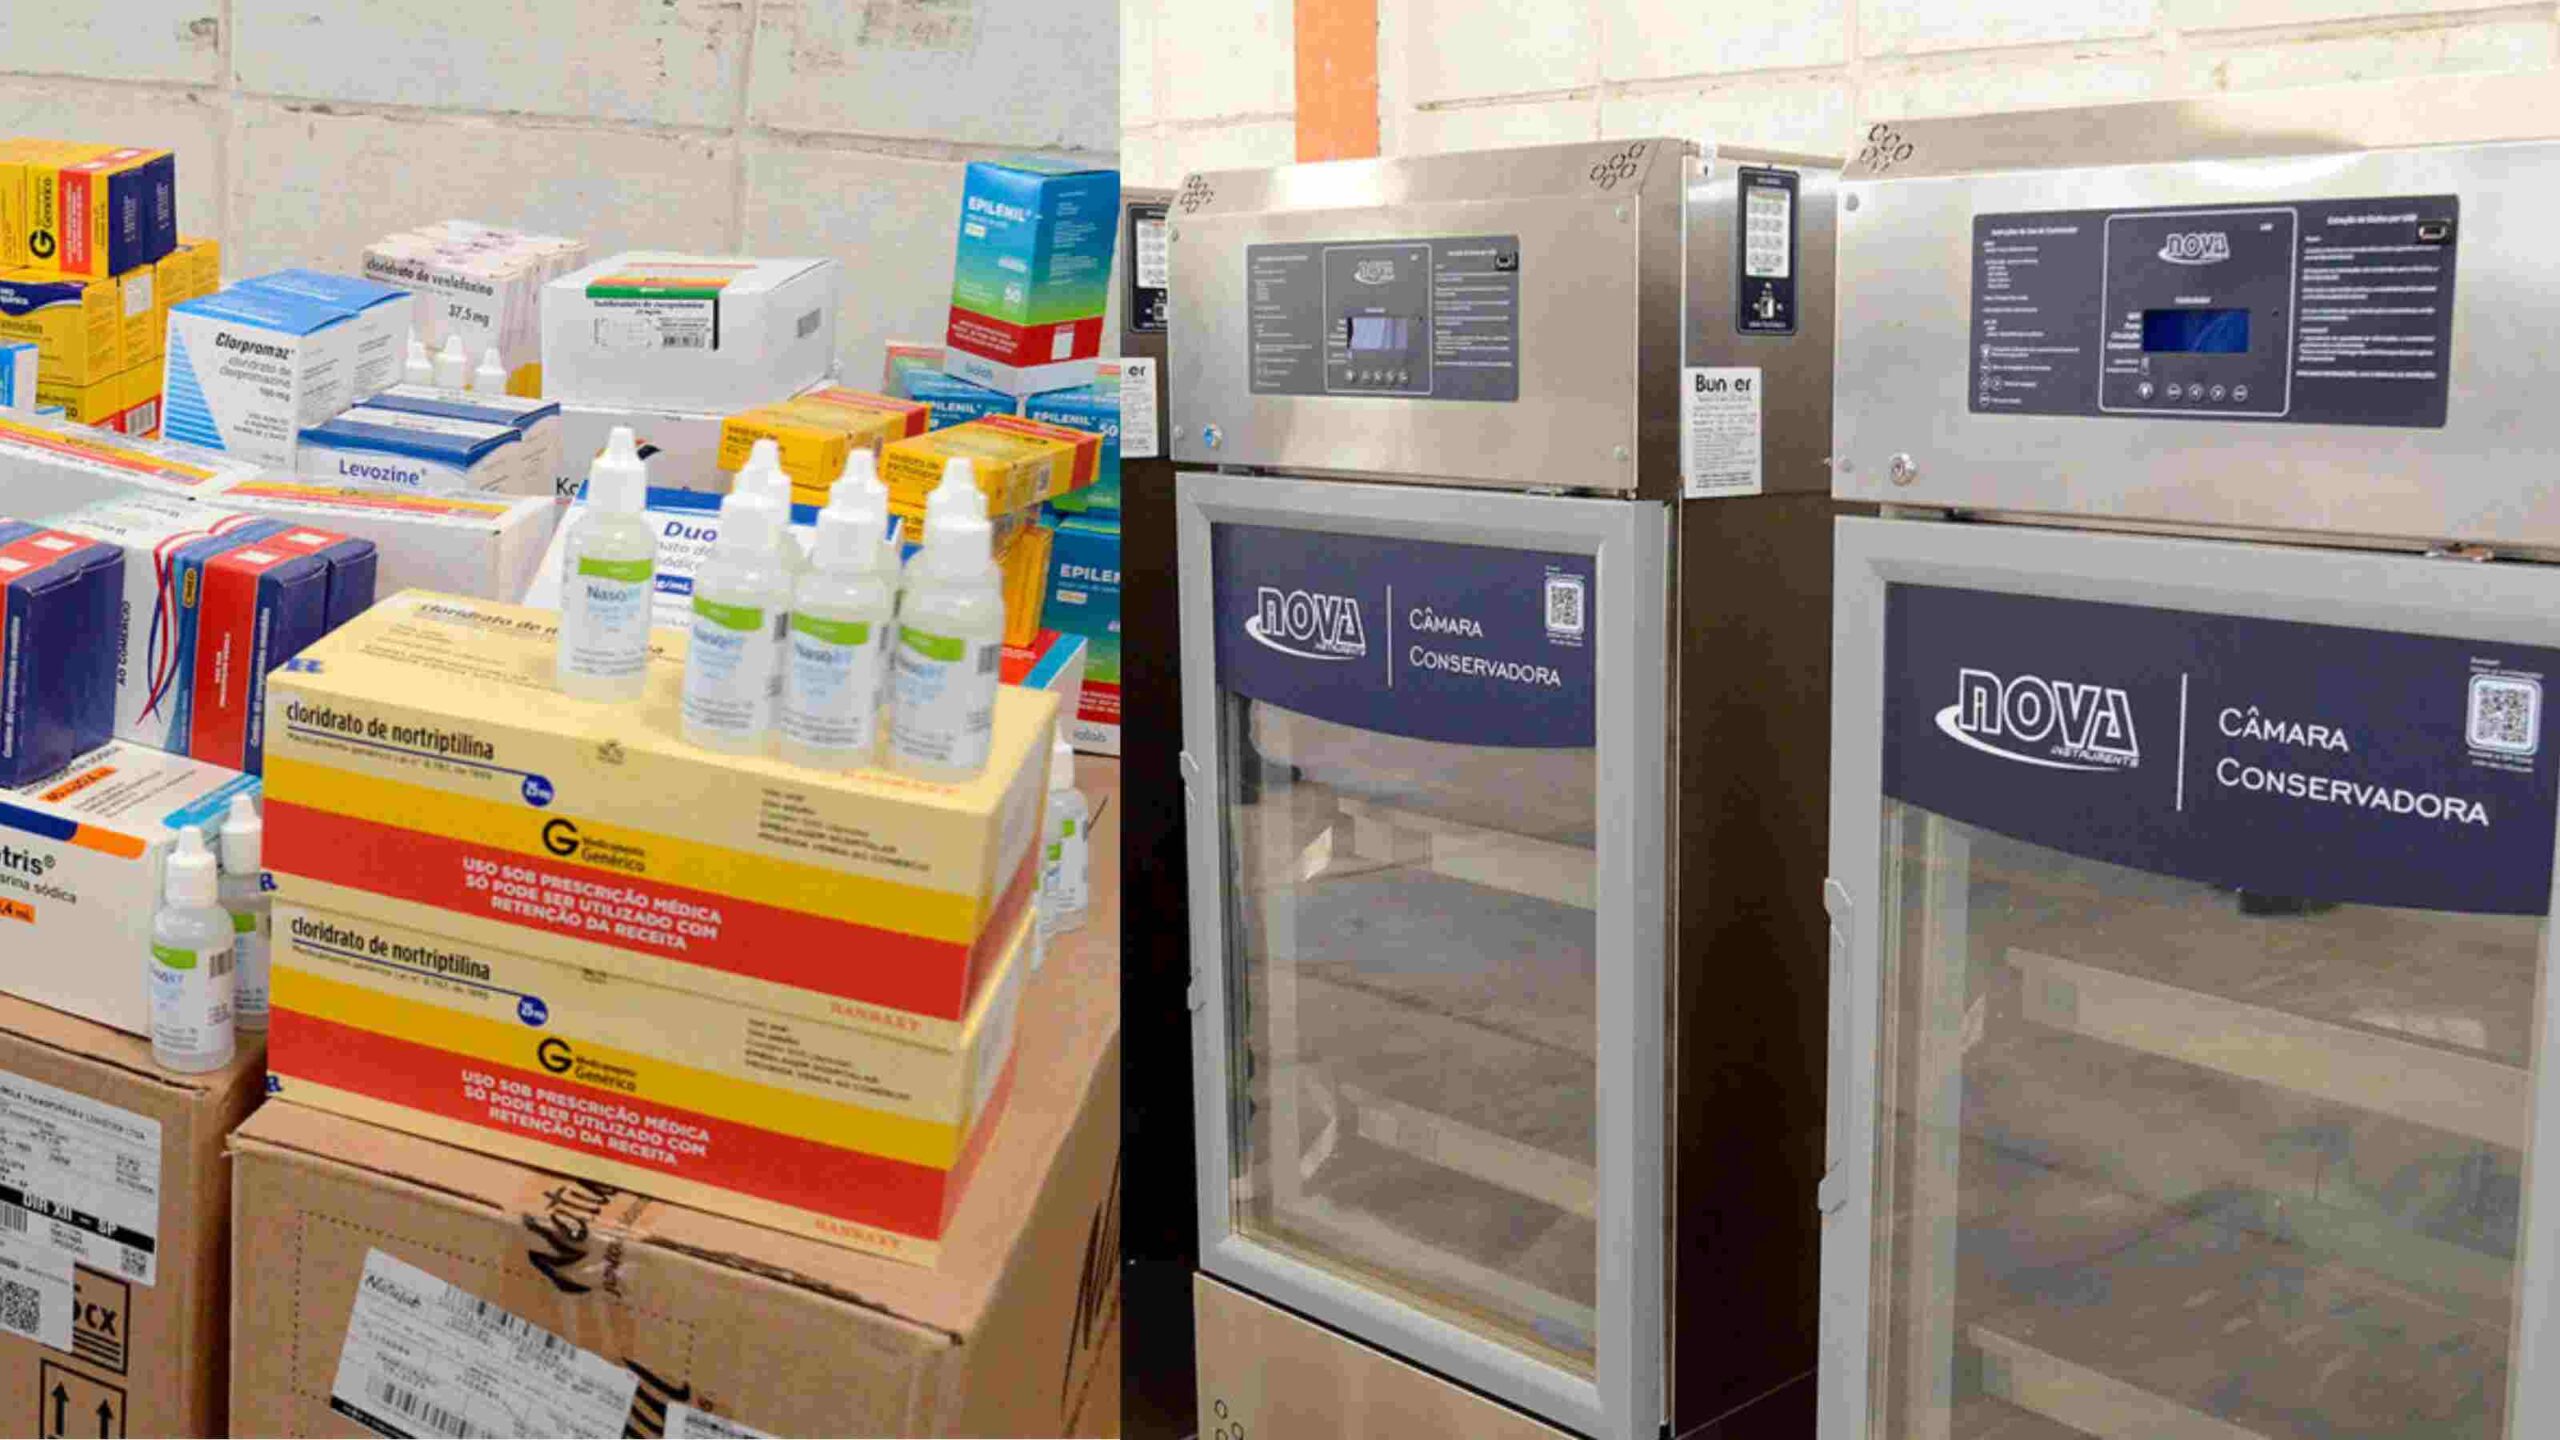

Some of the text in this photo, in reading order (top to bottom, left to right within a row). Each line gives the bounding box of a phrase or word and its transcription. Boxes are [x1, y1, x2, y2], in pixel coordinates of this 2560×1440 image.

[416, 270, 430, 284] de
[474, 312, 490, 328] mg
[664, 520, 717, 543] Duo
[1257, 586, 1366, 648] NOVA
[1408, 607, 1484, 638] CÂMARA
[1408, 645, 1562, 688] CONSERVADORA
[286, 700, 495, 760] cloridrato de nortriptilina
[1958, 667, 2141, 757] NOVA
[2218, 705, 2350, 753] CÂMARA
[2215, 756, 2490, 827] CONSERVADORA
[0, 843, 56, 876] tris®
[542, 818, 579, 856] G
[581, 848, 646, 873] Genérico
[463, 856, 723, 925] USO SOB PRESCRIÇÃO MÉDICA
[464, 872, 719, 939] SÓ PODE SER UTILIZADO COM
[291, 916, 492, 981] cloridrato de nortriptilina
[491, 895, 688, 951] RETENÇÃO DA RECEITA
[536, 1037, 573, 1074] G
[574, 1066, 637, 1092] Genérico
[461, 1069, 711, 1143] USO SOB PRESCRIÇÃO MÉDICA
[463, 1085, 707, 1157] SÓ PODE SER UTILIZADO COM
[488, 1107, 679, 1166] RETENÇÃO DA RECEITA
